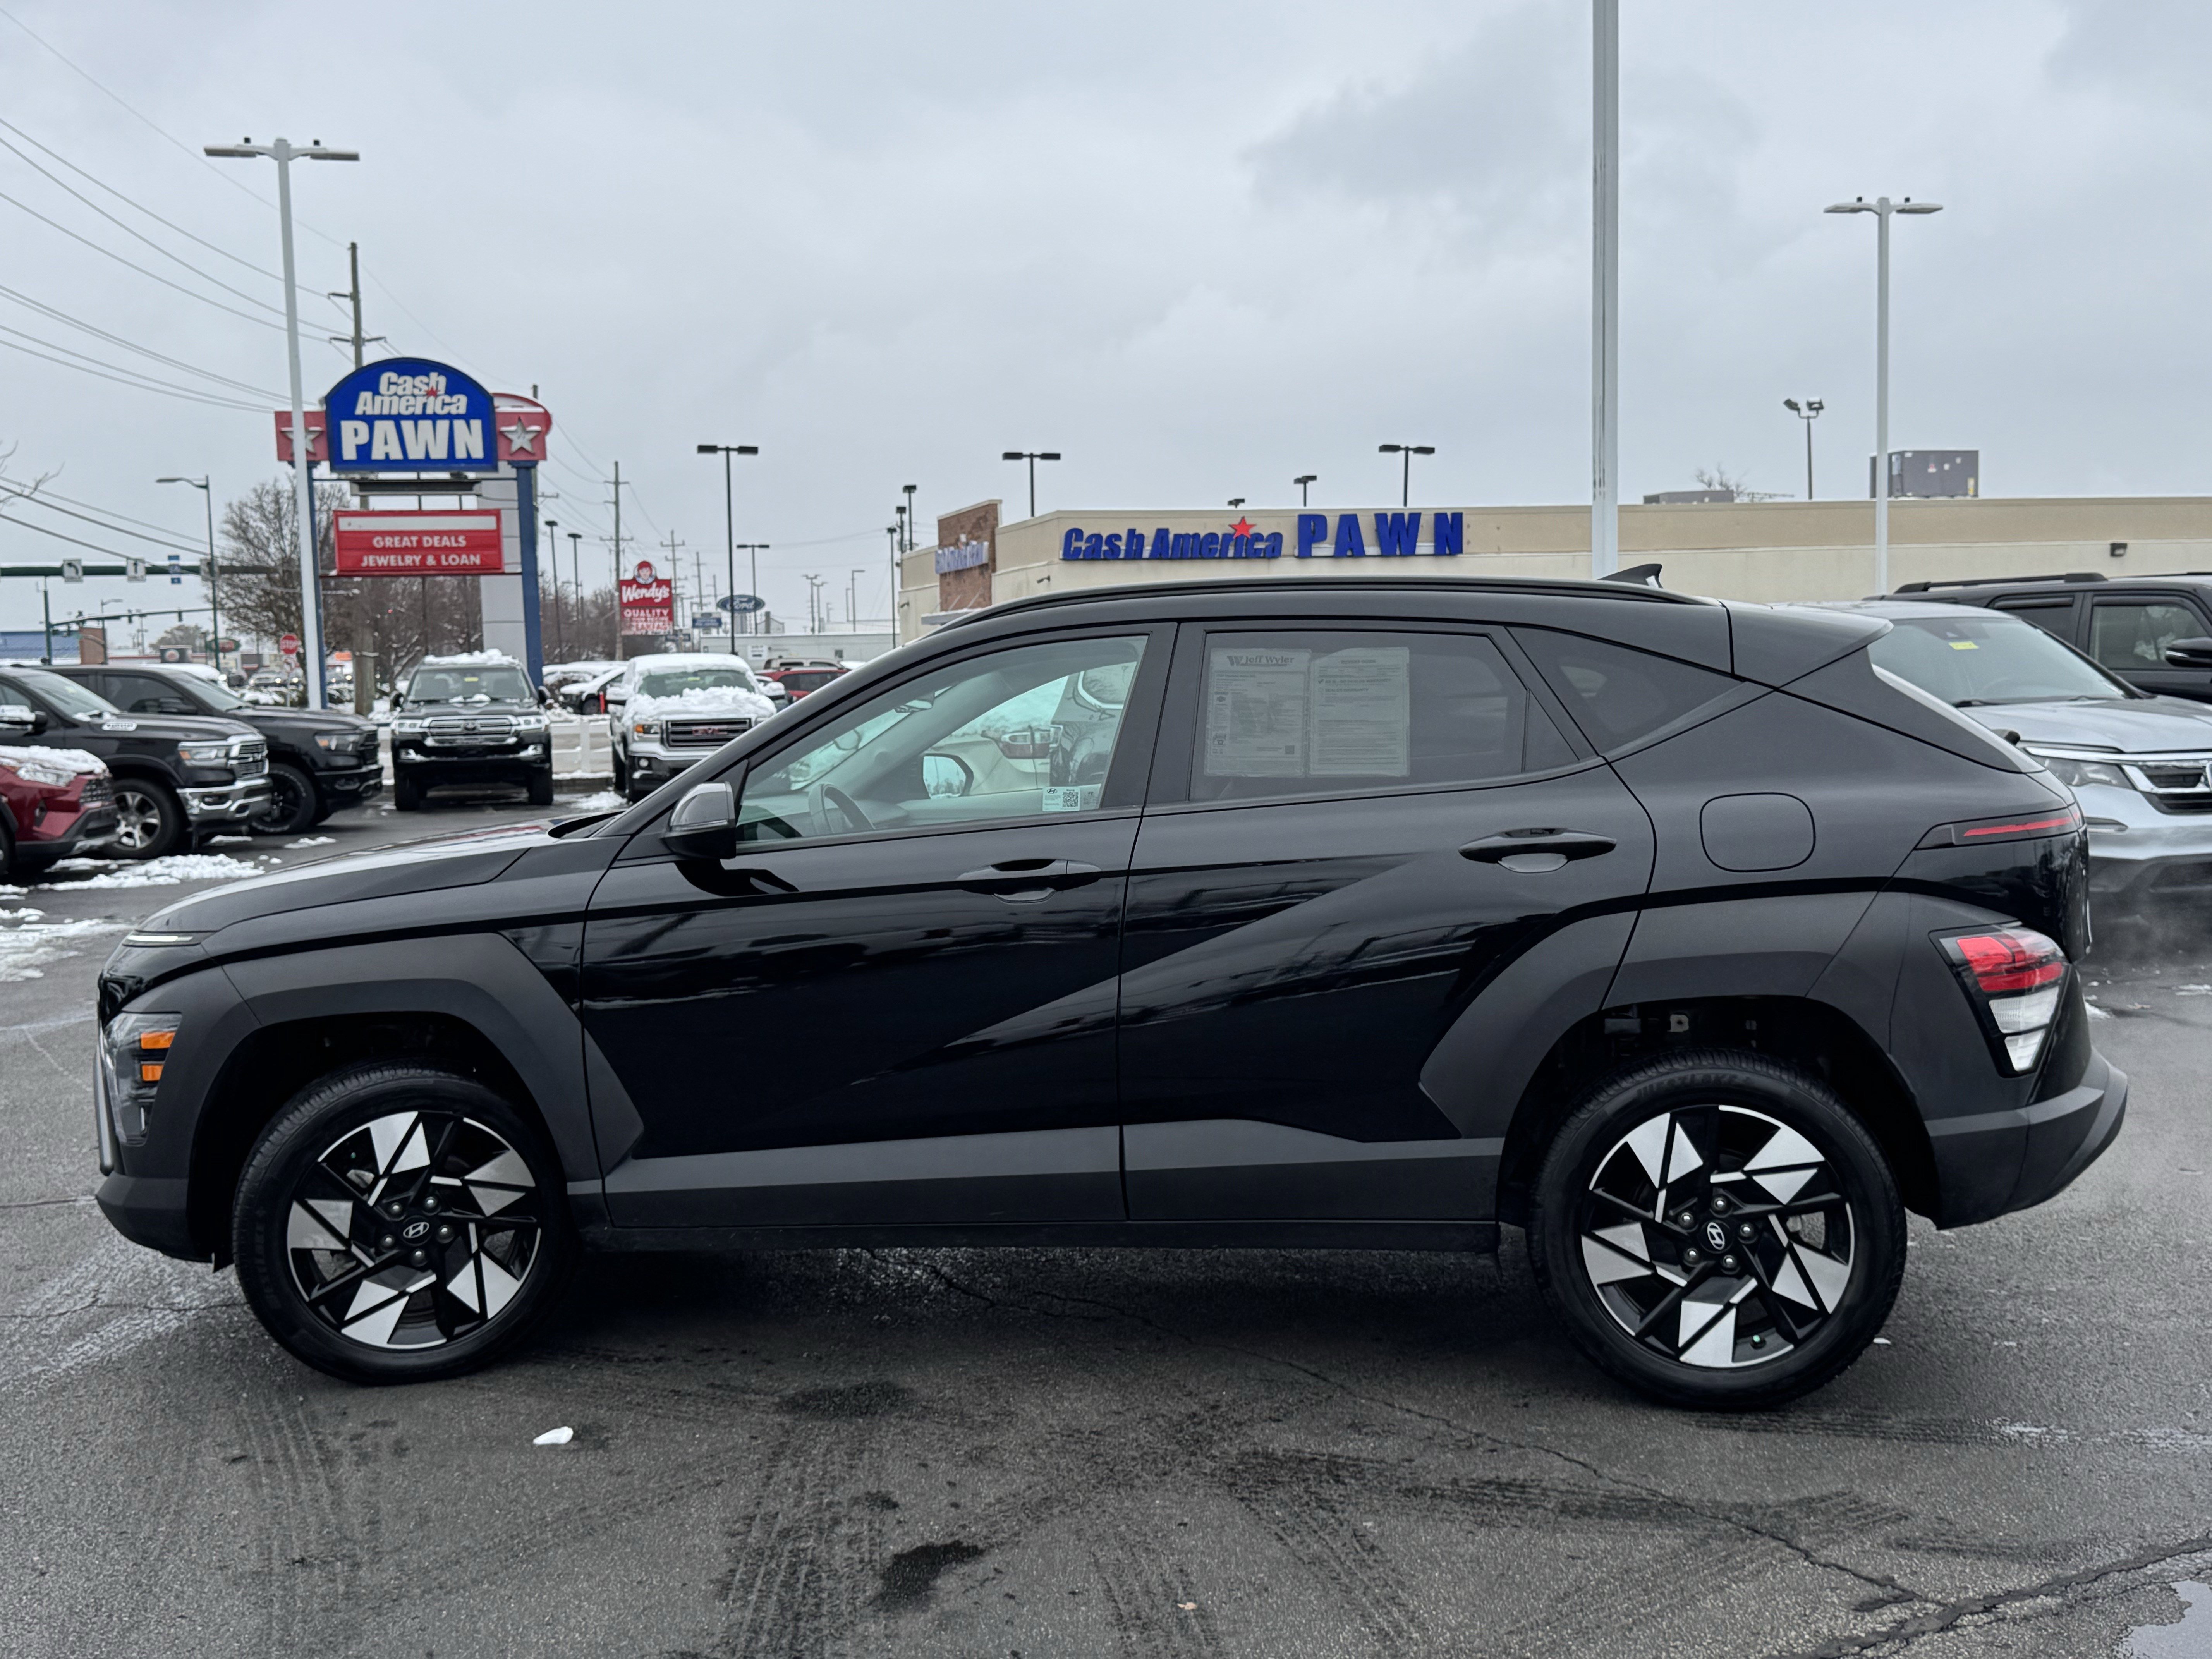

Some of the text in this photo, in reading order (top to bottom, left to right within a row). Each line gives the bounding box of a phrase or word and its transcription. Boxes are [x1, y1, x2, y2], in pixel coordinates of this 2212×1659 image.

[379, 371, 447, 395] Cash
[355, 391, 467, 415] America
[340, 419, 484, 460] PAWN
[372, 535, 467, 548] GREAT DEALS
[1062, 527, 1283, 559] Cash America
[1298, 512, 1463, 558] PAWN
[361, 554, 481, 567] JEWELRY & LOAN
[622, 582, 670, 603] Wendy's
[623, 608, 669, 617] QUALITY
[1245, 655, 1264, 664] Jeff
